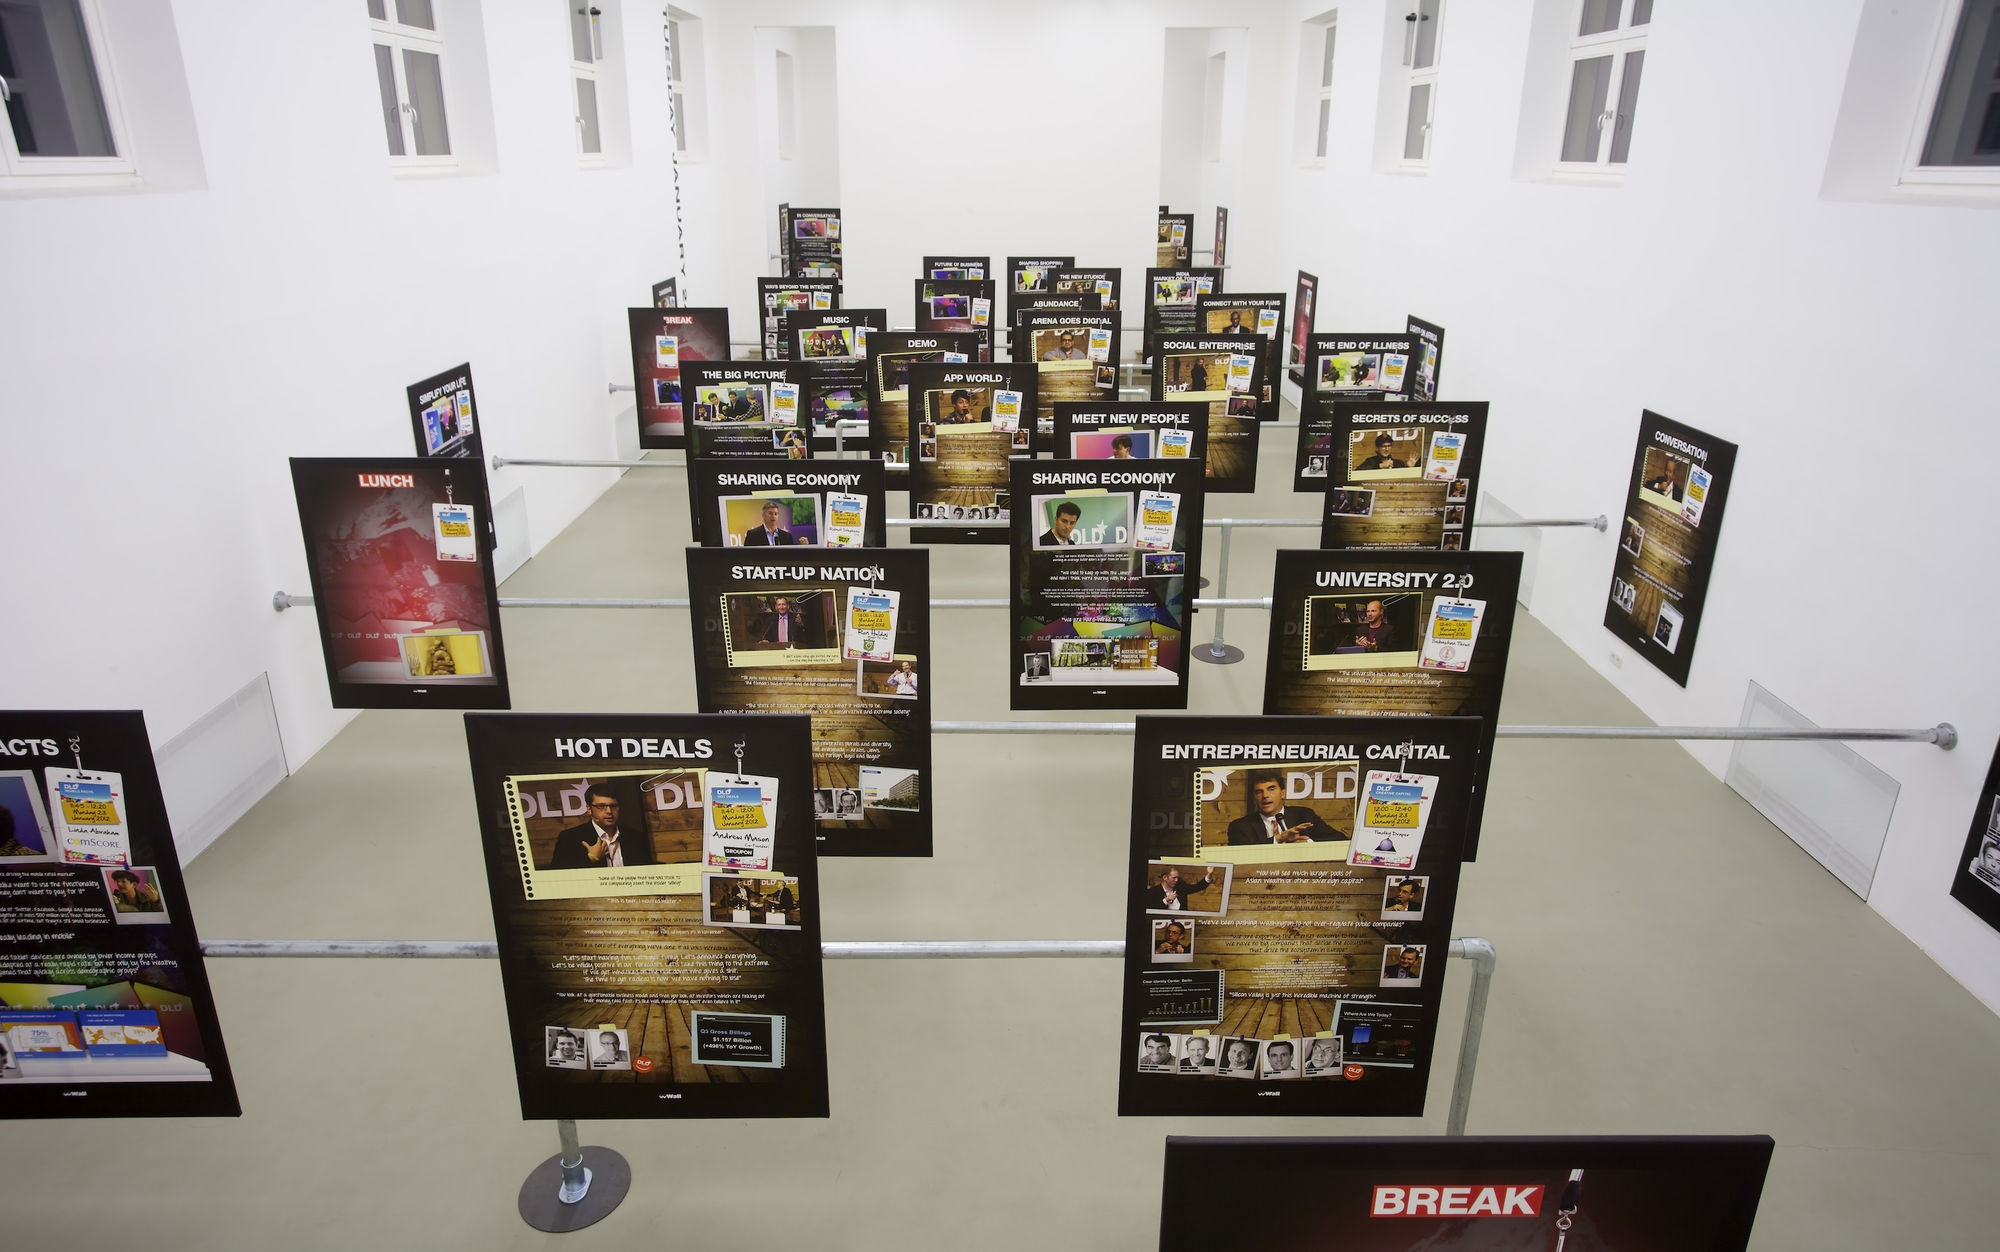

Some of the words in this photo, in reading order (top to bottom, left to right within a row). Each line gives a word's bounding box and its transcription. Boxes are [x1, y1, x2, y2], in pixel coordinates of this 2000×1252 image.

[672, 152, 686, 277] JANUARY
[1033, 300, 1080, 308] ABUNDANCE
[1203, 301, 1231, 309] CONNECT
[822, 316, 850, 325] MUSIC
[1031, 317, 1058, 326] ARENA
[1060, 317, 1081, 326] GOES
[907, 340, 938, 349] DEMO
[1163, 342, 1197, 351] SOCIAL
[1199, 342, 1256, 352] ENTERPRISE
[1317, 342, 1336, 351] THE
[1337, 342, 1357, 351] END
[1358, 342, 1371, 351] OF
[1372, 342, 1410, 352] ILLNESS
[702, 370, 724, 381] THE
[724, 370, 740, 381] BIG
[740, 370, 786, 381] PICTURE
[944, 373, 964, 383] APP
[965, 373, 1003, 383] WORLD
[419, 387, 443, 405] SIMPLIFY
[442, 382, 457, 395] YOUR
[1071, 413, 1107, 425] MEET
[1109, 413, 1139, 425] NEW
[1351, 414, 1401, 425] SECRETS
[1402, 414, 1418, 425] OF
[1655, 431, 1708, 463] CONVERSATION
[358, 473, 414, 488] LUNCH
[717, 473, 783, 486] SHARING
[786, 473, 862, 486] ECONOMY
[1032, 472, 1098, 486] SHARING
[1101, 472, 1178, 486] ECONOMY
[731, 565, 816, 581] START-UP
[820, 566, 885, 582] NATION
[1315, 570, 1438, 588] UNIVERSITY
[554, 738, 613, 759] HOT
[620, 738, 714, 760] DEALS
[1160, 743, 1361, 761] ENTREPRENEURIAL
[72, 814, 97, 823] January
[97, 815, 111, 823] 2012
[73, 809, 97, 818] Monday
[1374, 812, 1398, 820] Monday
[721, 820, 744, 828] January
[1371, 819, 1395, 827] January
[713, 832, 743, 841] Andrew
[744, 834, 770, 843] Mason
[725, 848, 753, 856] GROUPON
[1373, 1186, 1539, 1215] BREAK
